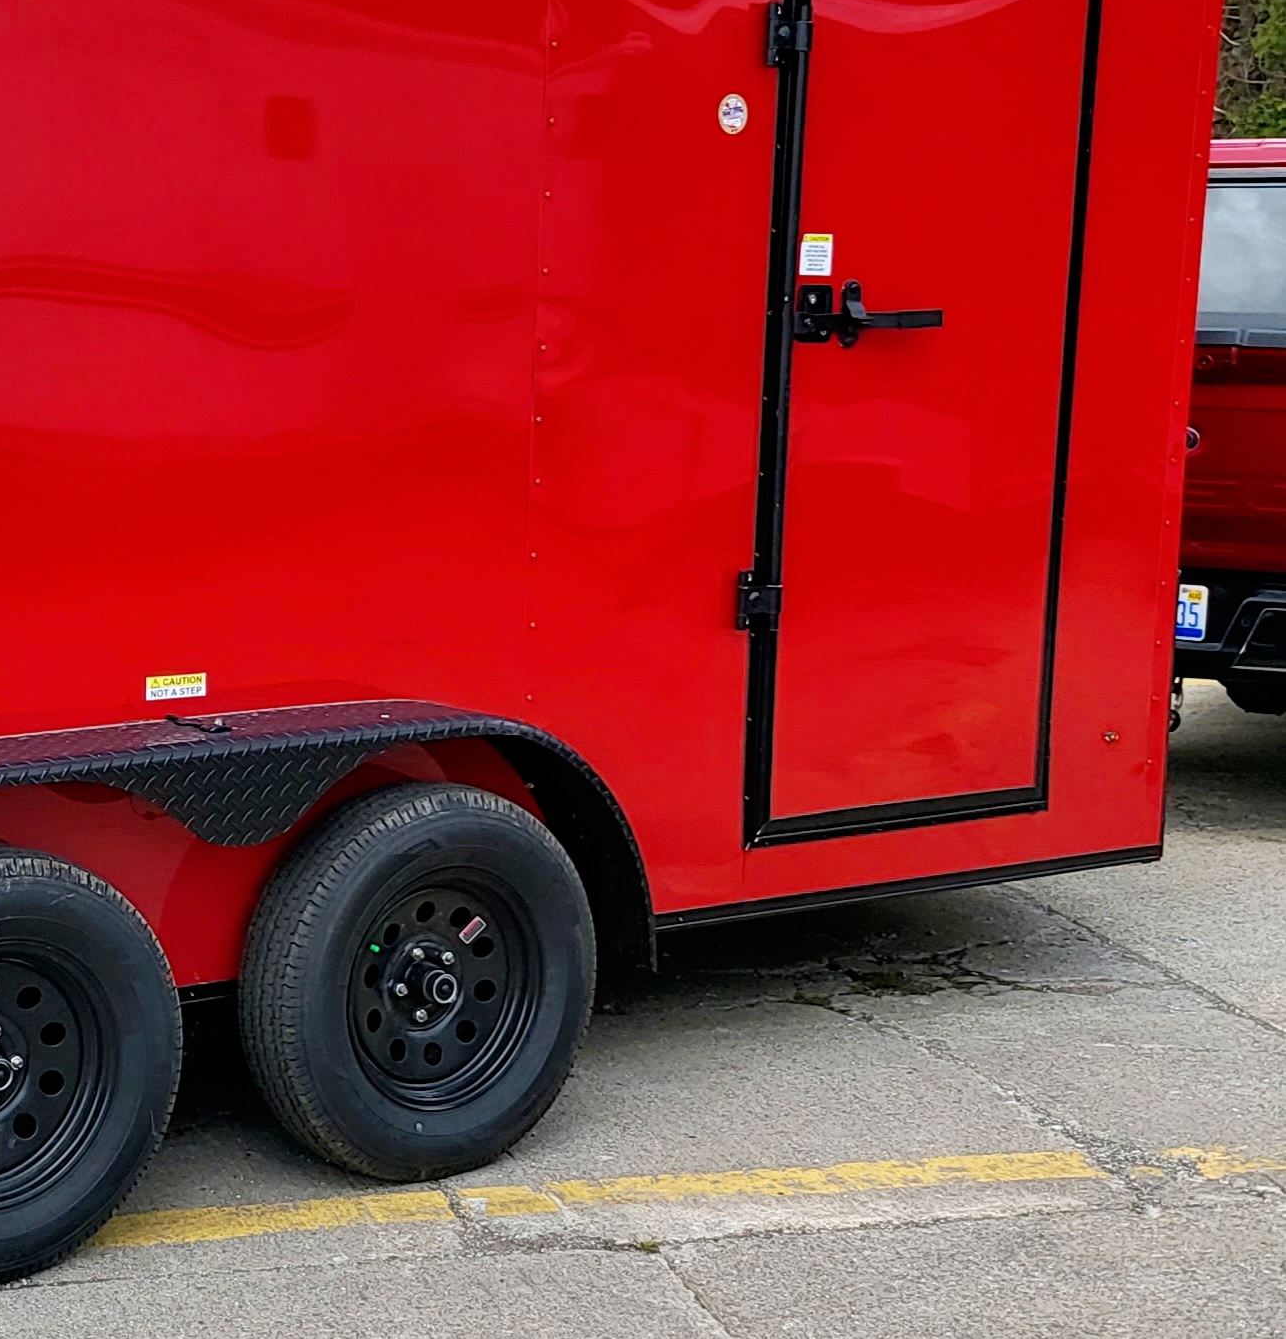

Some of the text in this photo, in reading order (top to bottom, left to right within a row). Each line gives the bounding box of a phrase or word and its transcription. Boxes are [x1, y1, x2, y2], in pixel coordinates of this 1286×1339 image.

[162, 675, 203, 686] CAUTION
[150, 686, 202, 698] NOT A STEP
